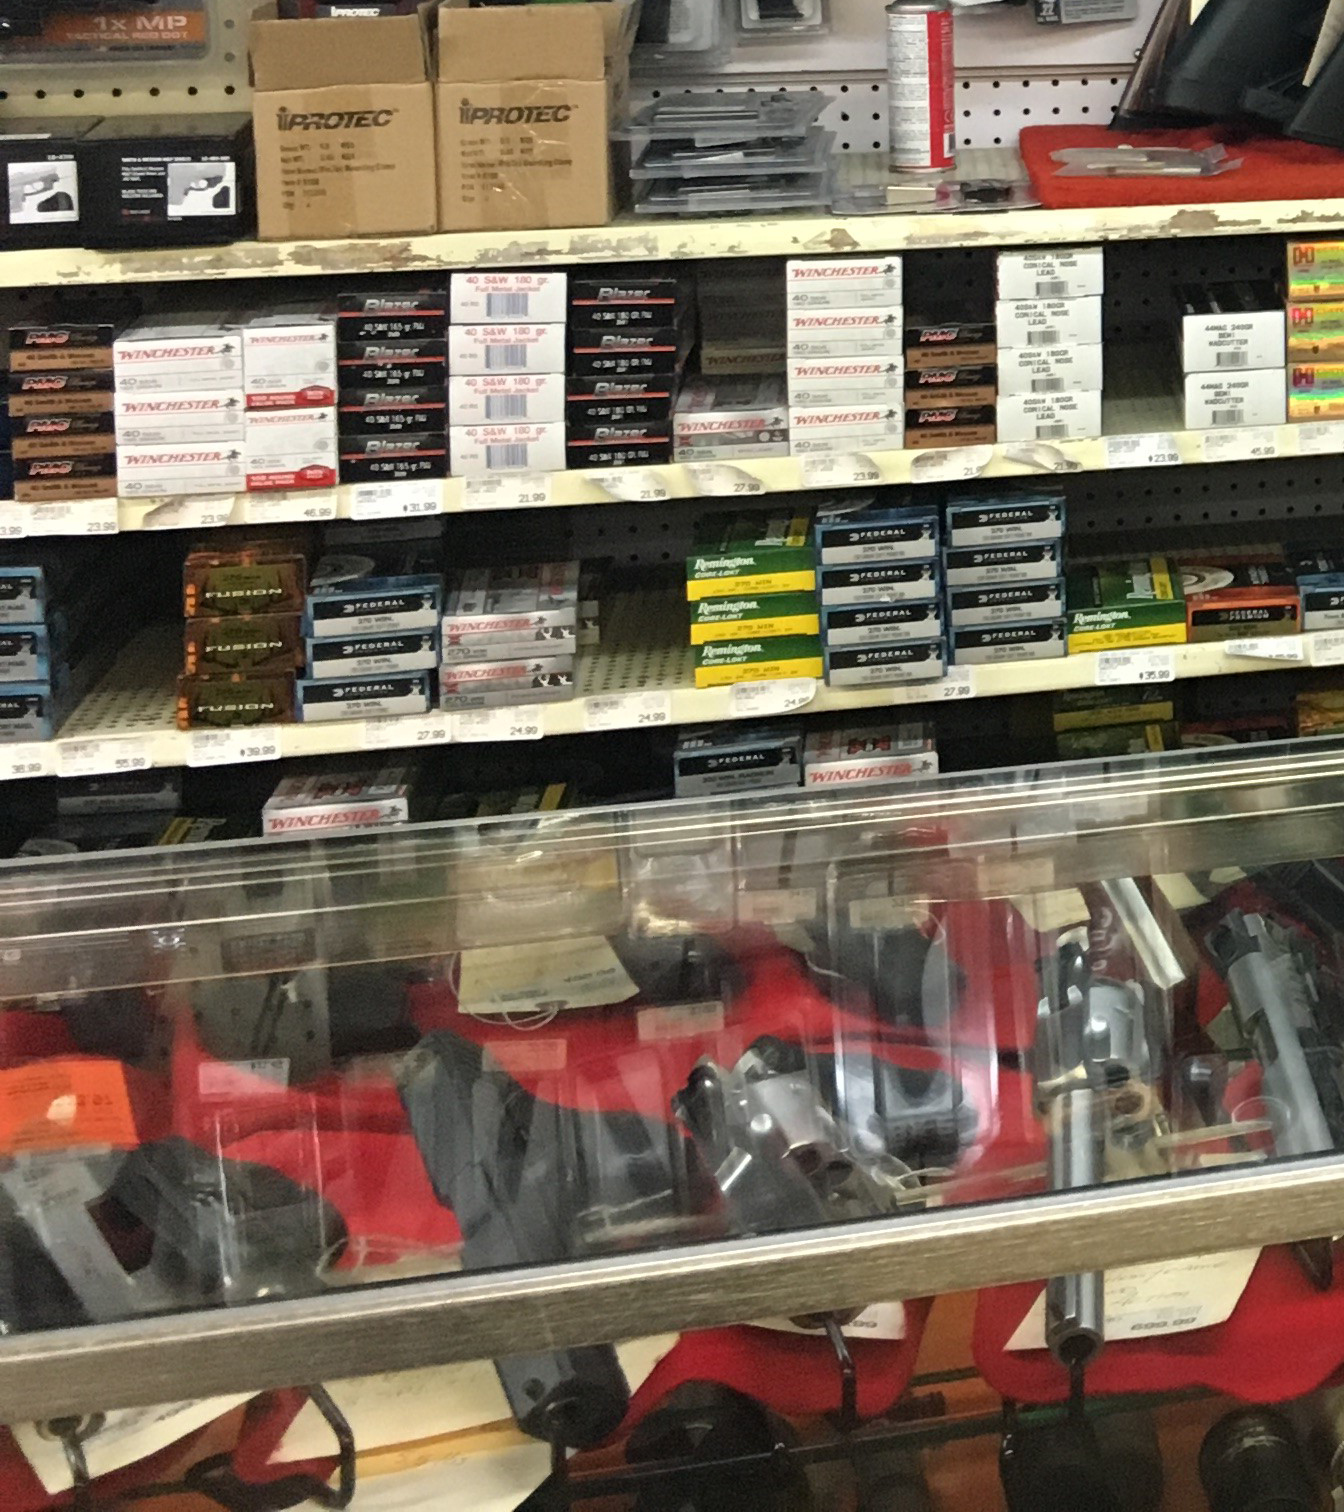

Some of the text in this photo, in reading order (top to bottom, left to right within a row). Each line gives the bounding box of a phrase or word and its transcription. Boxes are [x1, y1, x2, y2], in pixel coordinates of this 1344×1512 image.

[136, 15, 187, 30] MP
[792, 265, 879, 278] WINCHESTER
[466, 276, 480, 285] 40
[484, 276, 508, 285] S&W
[515, 276, 533, 285] 180
[794, 315, 879, 328] WINCHESTER
[249, 333, 317, 345] WINCHESTER
[117, 346, 215, 361] WINCHESTER
[795, 365, 881, 377] WINCHESTER
[122, 399, 220, 414] WINCHESTER
[248, 413, 316, 424] WINCHESTER
[794, 412, 880, 425] WINCHESTER
[679, 418, 766, 433] WINCHESTER
[124, 451, 222, 466] WINCHESTER
[989, 510, 1034, 522] FEDERAL
[984, 550, 1029, 561] FEDERAL
[694, 557, 755, 572] Remington
[205, 587, 282, 599] FUSION
[355, 598, 406, 610] FEDERAL
[698, 601, 759, 616] Remington
[865, 609, 912, 620] FEDERAL
[1074, 610, 1130, 625] Remington
[447, 618, 532, 633] WINCHESTER
[205, 640, 282, 653] FUSION
[702, 643, 762, 658] Remington
[344, 682, 395, 694] FEDERAL
[198, 701, 275, 713] FUSION
